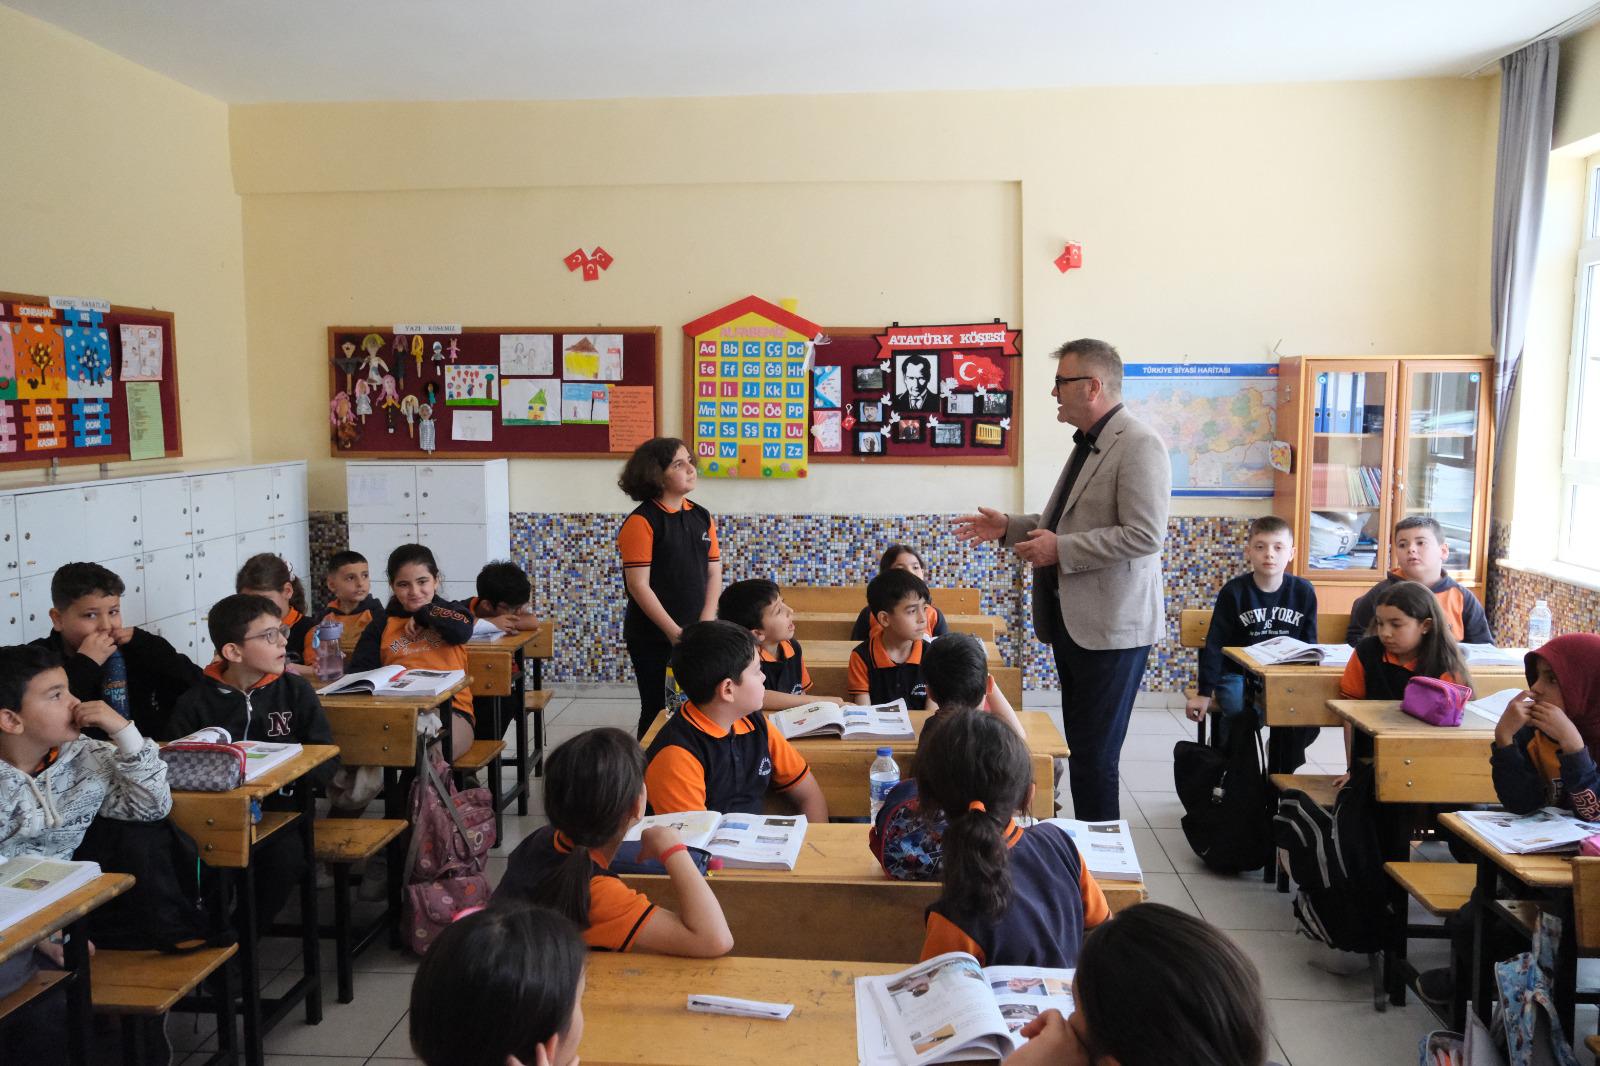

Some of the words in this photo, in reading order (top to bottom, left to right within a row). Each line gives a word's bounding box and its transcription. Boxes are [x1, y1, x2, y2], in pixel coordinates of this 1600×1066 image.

[888, 333, 953, 345] ATATÜRK
[960, 331, 1006, 346] KÖŞESİ
[700, 344, 715, 353] Aa
[724, 344, 737, 354] Bb
[745, 345, 759, 354] Cc
[767, 344, 780, 356] Çç
[788, 345, 803, 355] Dd
[701, 364, 714, 374] Ee
[724, 364, 736, 375] Ff
[744, 364, 759, 374] Gg
[766, 385, 780, 396] Kk
[699, 405, 716, 415] Mm
[721, 405, 737, 415] Nn
[743, 405, 759, 415] Oo
[788, 406, 803, 416] Pp
[700, 425, 714, 434] Rr
[723, 425, 735, 435] Ss
[766, 427, 778, 436] Tt
[787, 426, 802, 436] Uu
[722, 446, 735, 456] Vv
[788, 446, 802, 456] Zz
[1239, 608, 1267, 627] NEW
[1272, 607, 1304, 626] YORK
[268, 712, 292, 736] N
